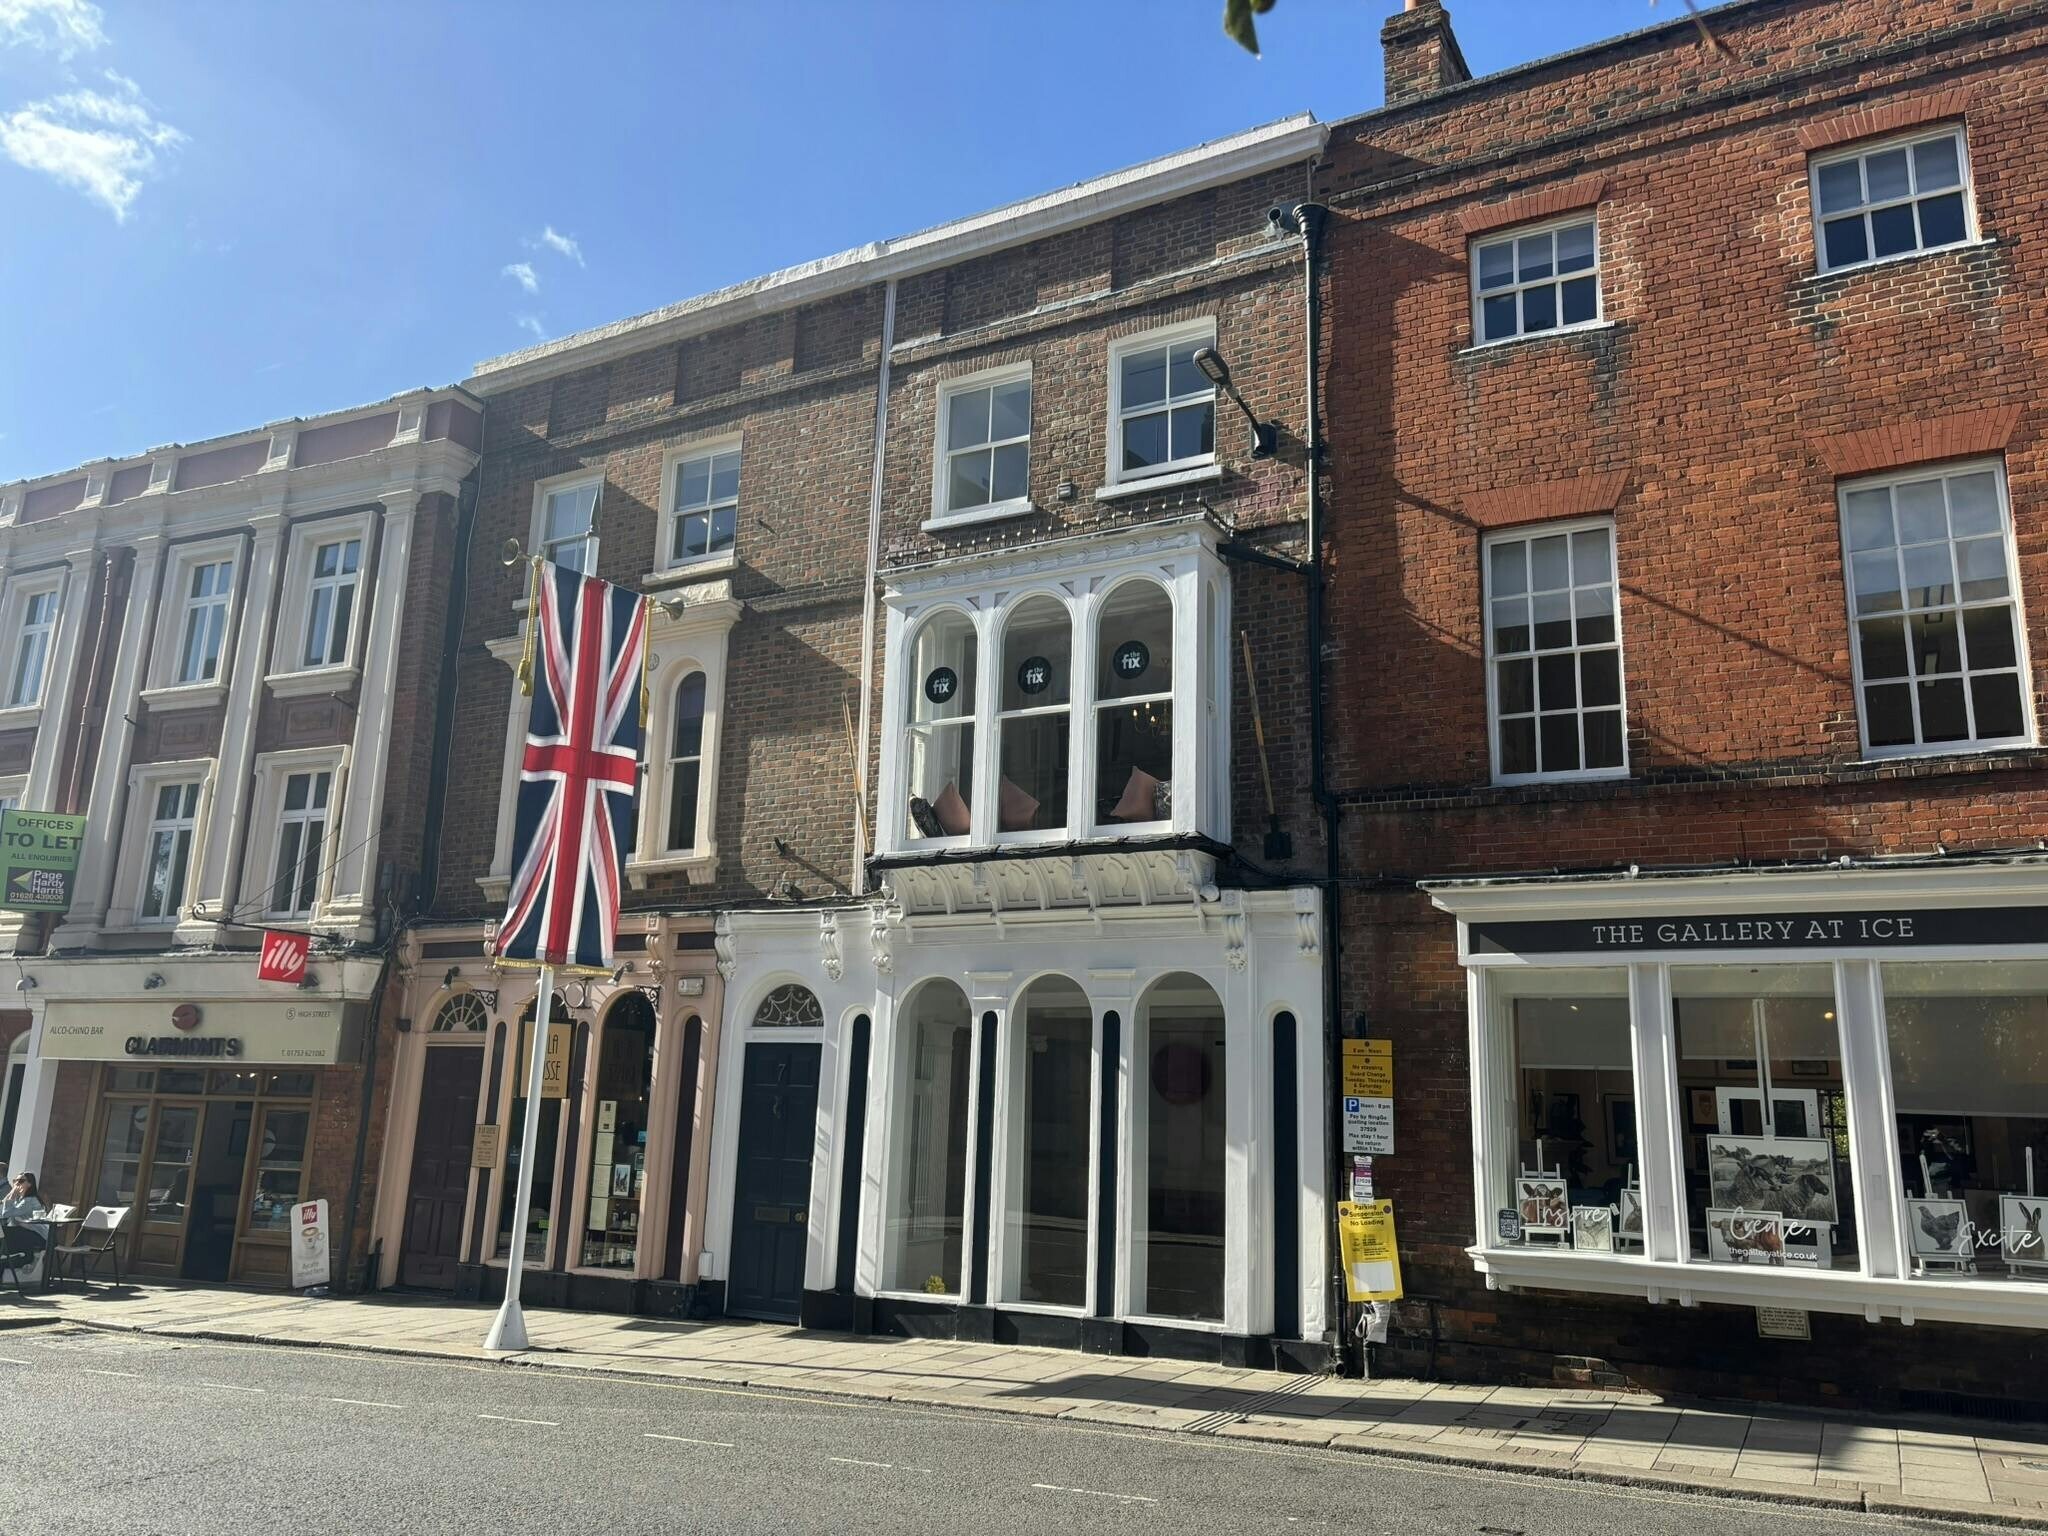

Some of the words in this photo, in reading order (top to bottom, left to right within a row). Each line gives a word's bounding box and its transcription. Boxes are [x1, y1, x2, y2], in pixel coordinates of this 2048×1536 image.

[1122, 654, 1141, 670] fix
[1026, 669, 1044, 685] fix
[933, 680, 950, 695] fix
[17, 818, 74, 831] OFFICES
[5, 832, 34, 848] TO
[42, 834, 83, 850] LET
[11, 852, 26, 860] ALL
[34, 870, 63, 881] Page
[33, 878, 65, 889] Hardy
[32, 886, 65, 896] Harris
[1593, 925, 1644, 944] THE
[1657, 921, 1794, 943] GALLERY
[1804, 919, 1844, 940] AT
[1859, 918, 1914, 939] ICE
[263, 939, 305, 978] illy
[50, 1025, 90, 1035] ALCO-CHINO
[90, 1026, 104, 1036] BAR
[1349, 1099, 1358, 1111] P
[303, 1208, 317, 1221] illy
[1349, 1210, 1385, 1218] Suspension
[1958, 1221, 2042, 1257] Excite
[1728, 1247, 1818, 1260] thegalleryatice.co.uk
